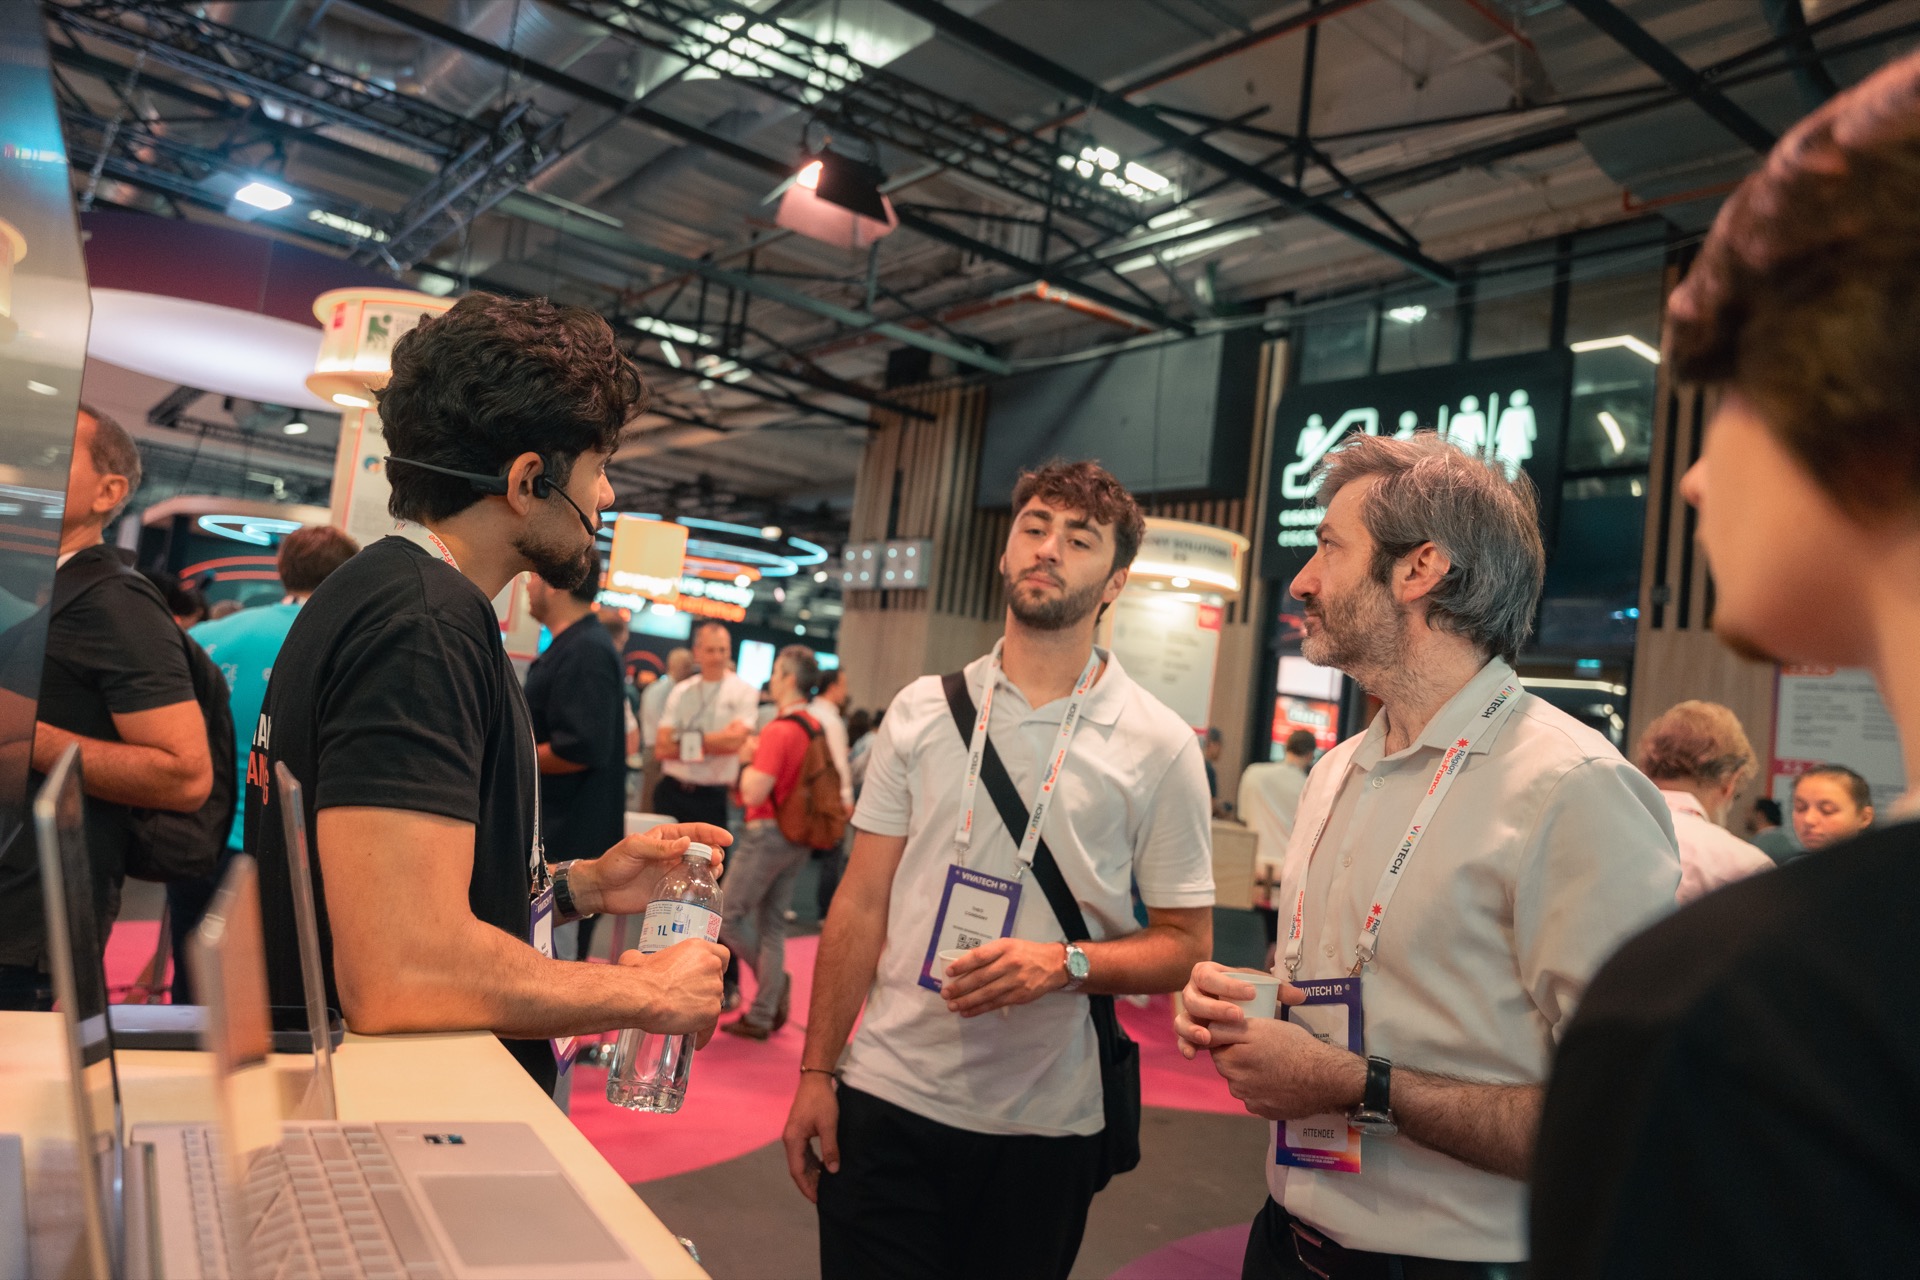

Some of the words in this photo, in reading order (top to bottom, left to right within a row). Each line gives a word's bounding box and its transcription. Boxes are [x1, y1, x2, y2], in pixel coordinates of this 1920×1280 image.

[1482, 685, 1516, 718] VIVATECH
[1062, 703, 1077, 736] VIVATECH
[1446, 750, 1466, 775] Région
[1028, 803, 1044, 840] VIVATECH
[1389, 825, 1422, 875] VIVATECH
[961, 871, 998, 889] VIVATECH
[1301, 986, 1332, 997] VATECH
[1303, 1128, 1335, 1139] ATTENDEE
